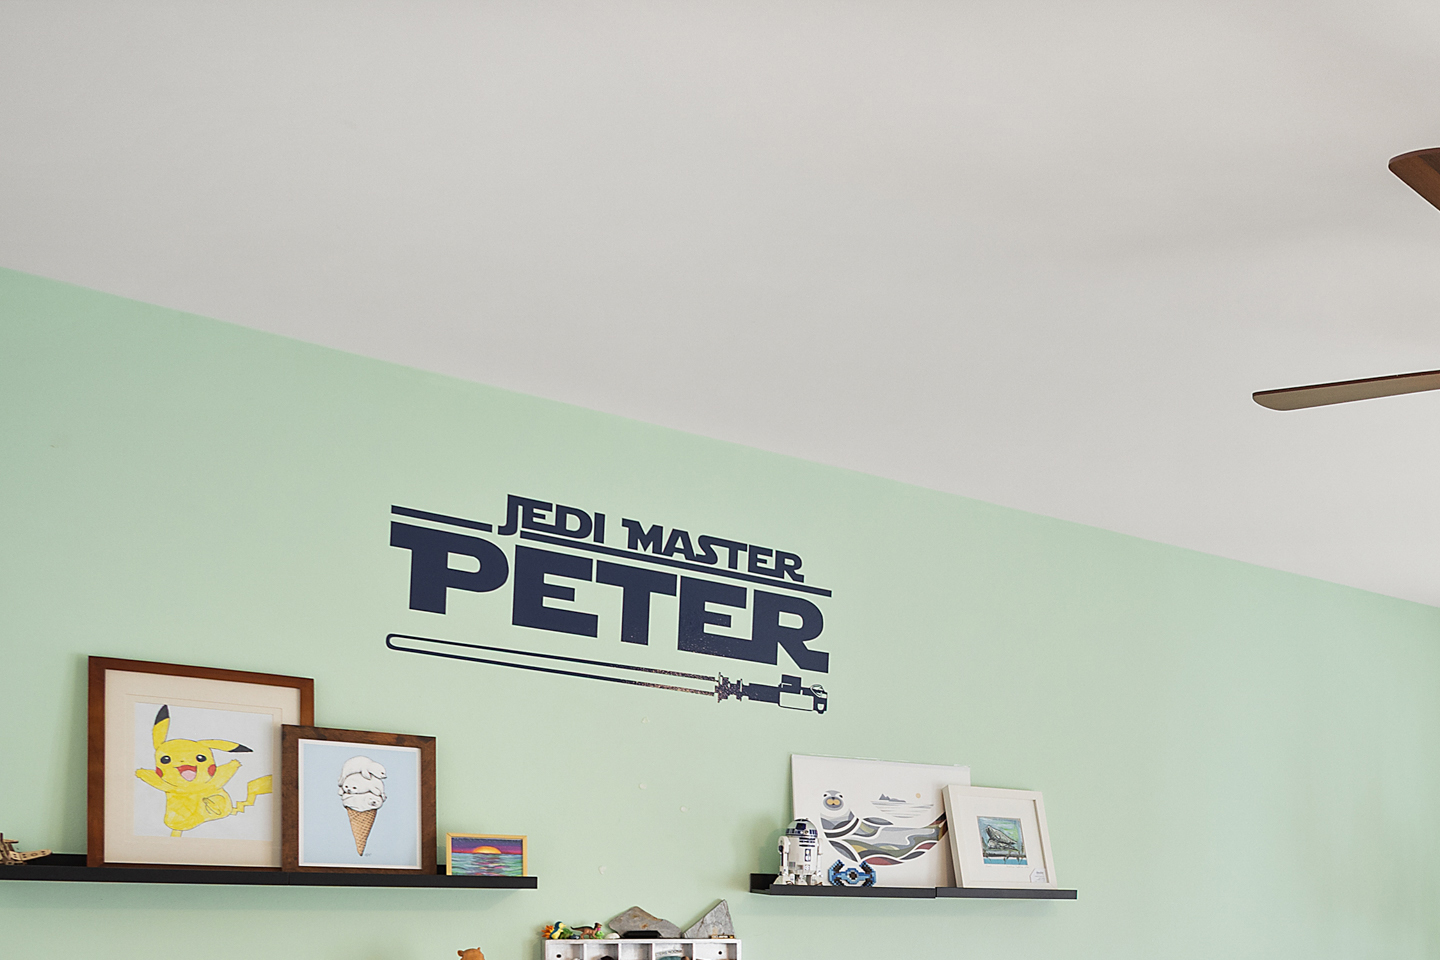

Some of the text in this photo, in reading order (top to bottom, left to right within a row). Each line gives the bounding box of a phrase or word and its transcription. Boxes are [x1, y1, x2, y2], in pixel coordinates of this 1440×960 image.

[389, 520, 830, 674] PETER
[498, 493, 805, 583] JEDI MASTER
